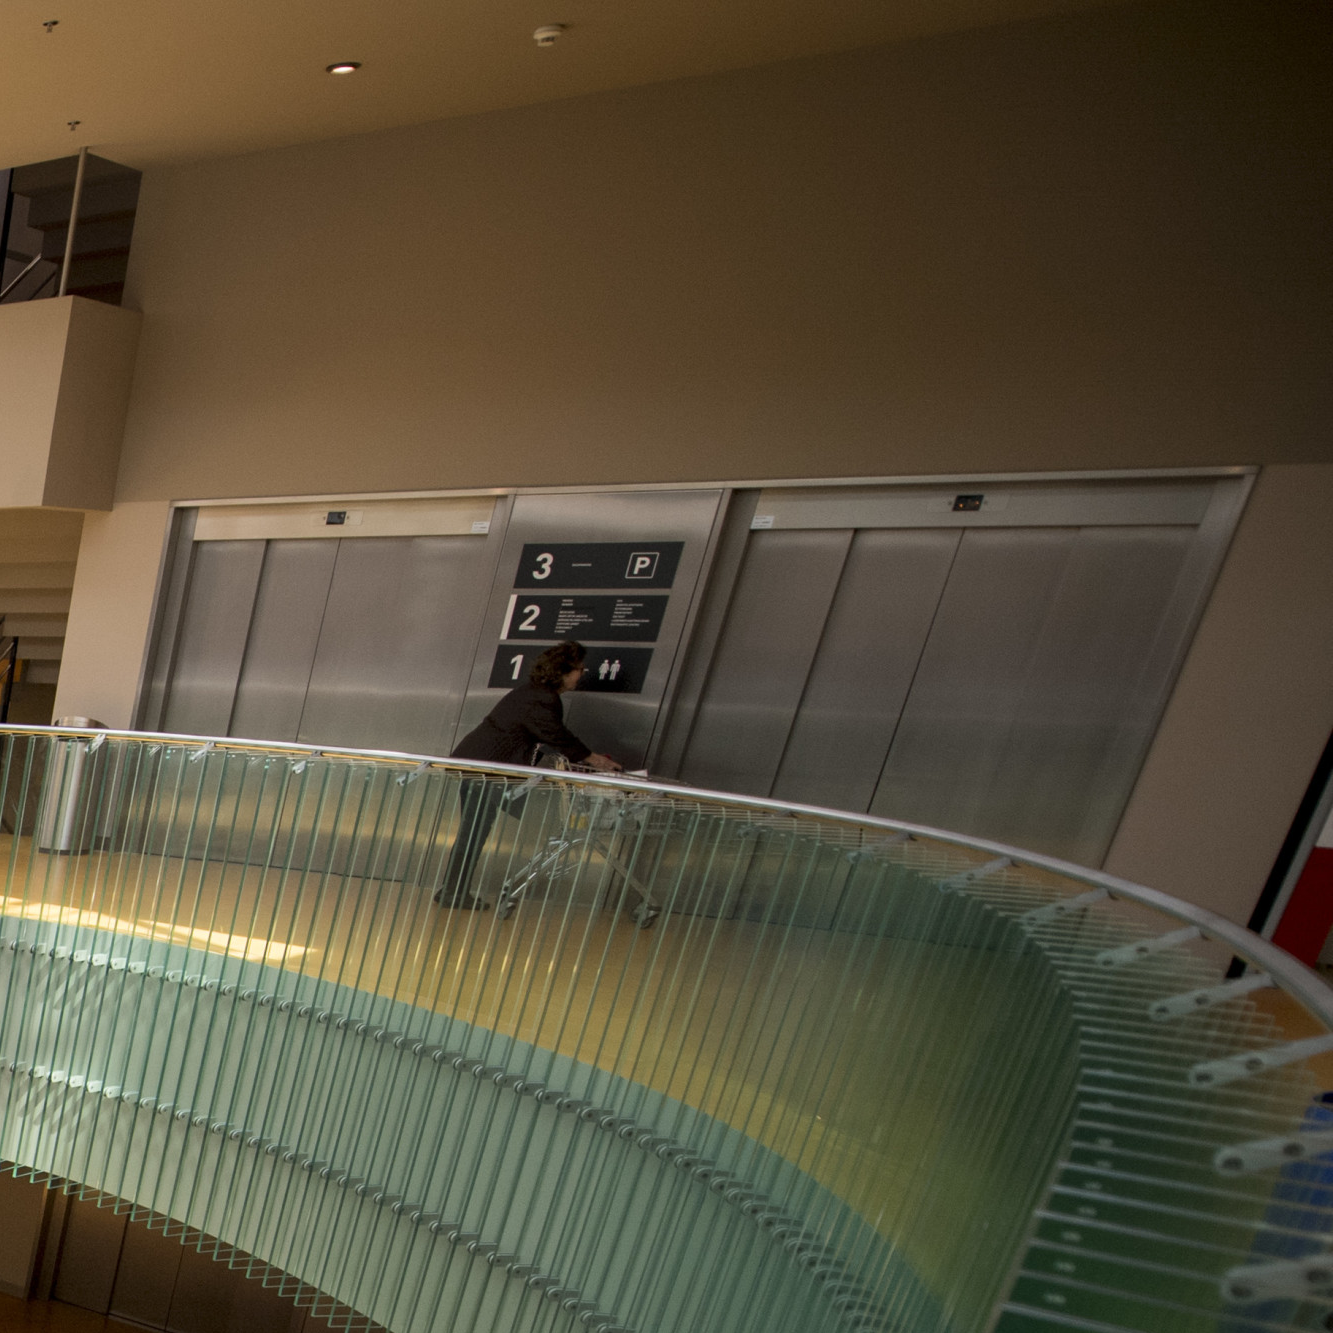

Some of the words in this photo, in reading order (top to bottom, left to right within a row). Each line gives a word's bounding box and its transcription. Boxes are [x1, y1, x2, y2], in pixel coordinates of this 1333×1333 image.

[533, 553, 554, 580] 3
[633, 557, 651, 575] P
[519, 605, 541, 630] 2
[510, 654, 524, 680] 1
